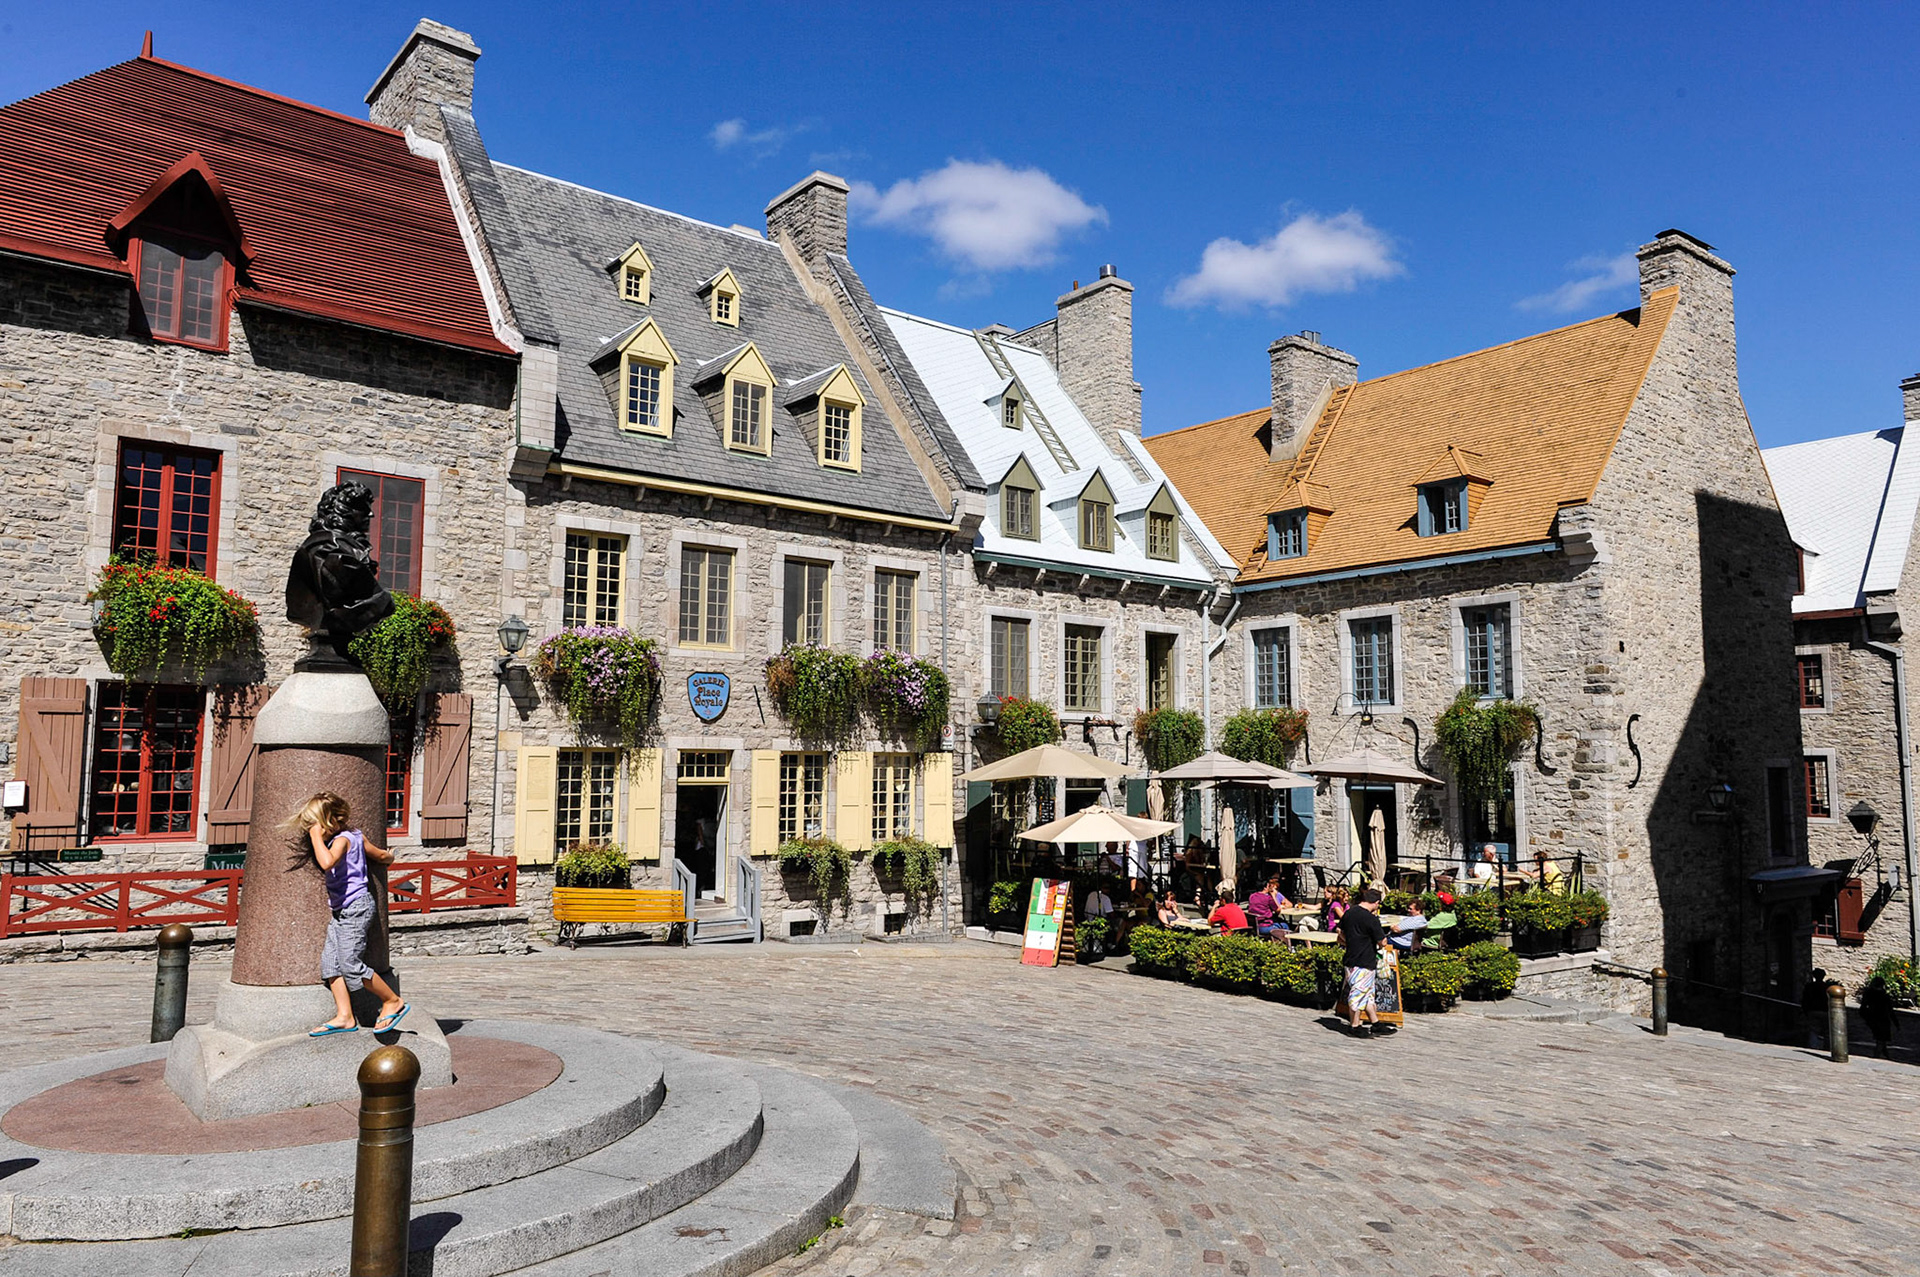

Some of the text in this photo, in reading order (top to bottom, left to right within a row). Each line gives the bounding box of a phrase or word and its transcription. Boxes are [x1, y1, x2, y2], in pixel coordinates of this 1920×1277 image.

[693, 676, 725, 688] GALERIE
[697, 687, 720, 697] Place
[694, 696, 723, 708] Royale
